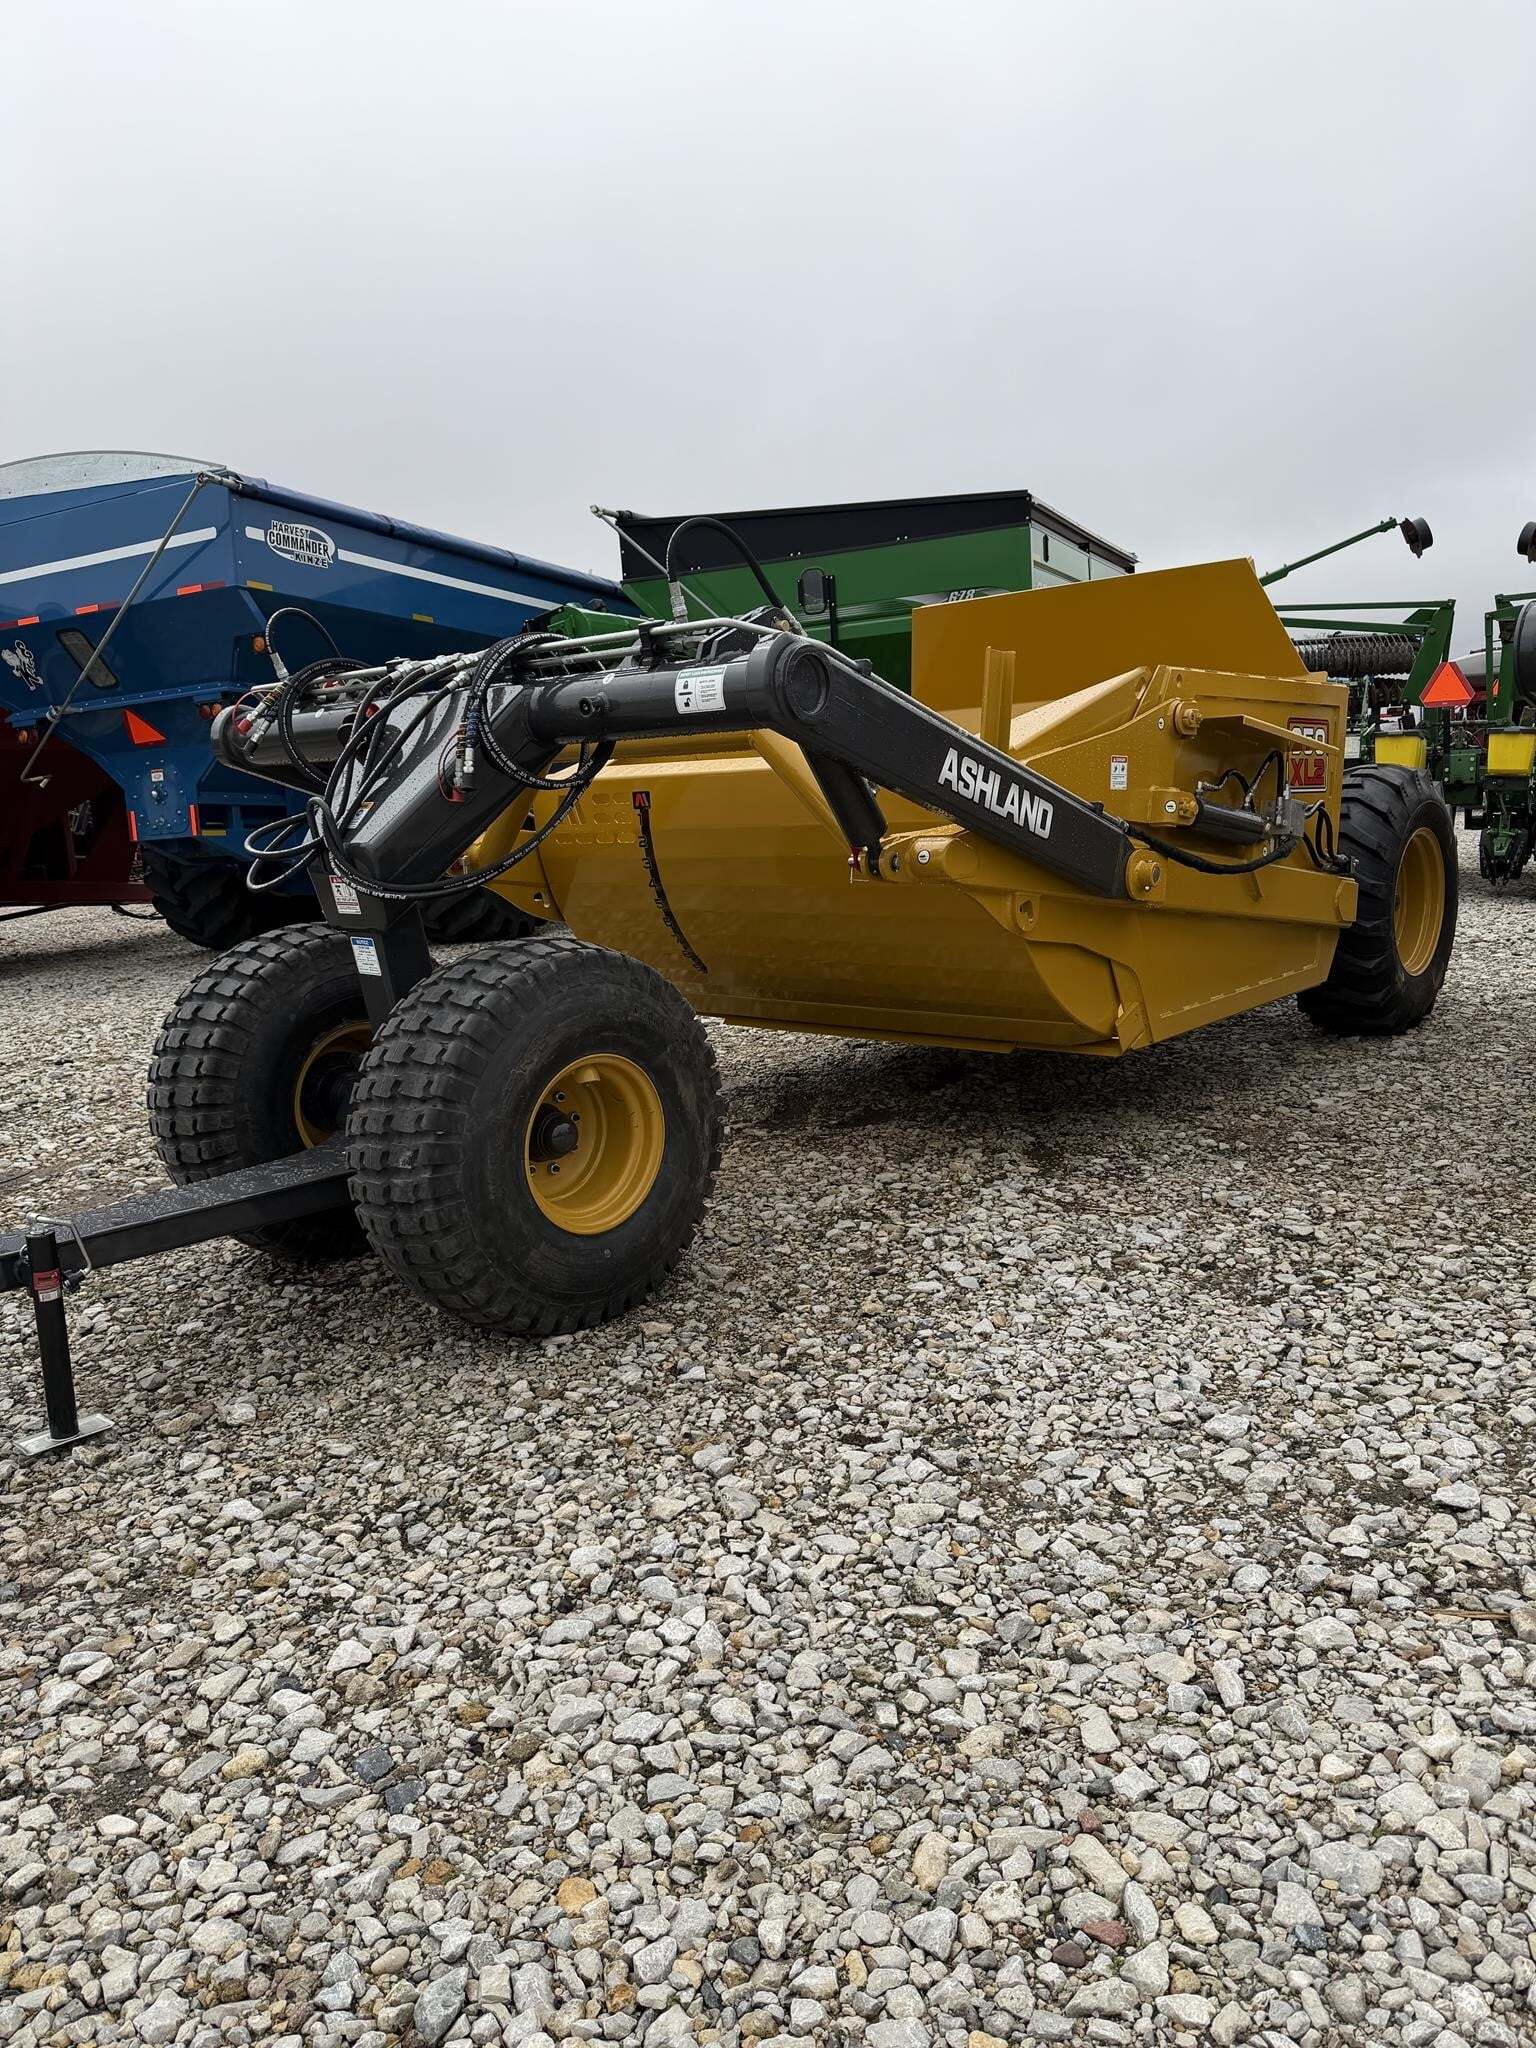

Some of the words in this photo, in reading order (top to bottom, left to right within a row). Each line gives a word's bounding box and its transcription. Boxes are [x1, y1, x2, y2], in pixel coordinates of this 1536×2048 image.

[272, 521, 310, 537] HARVEST
[269, 531, 331, 561] COMMANDER
[294, 552, 328, 568] KINZE
[938, 747, 1054, 839] ASHLAND
